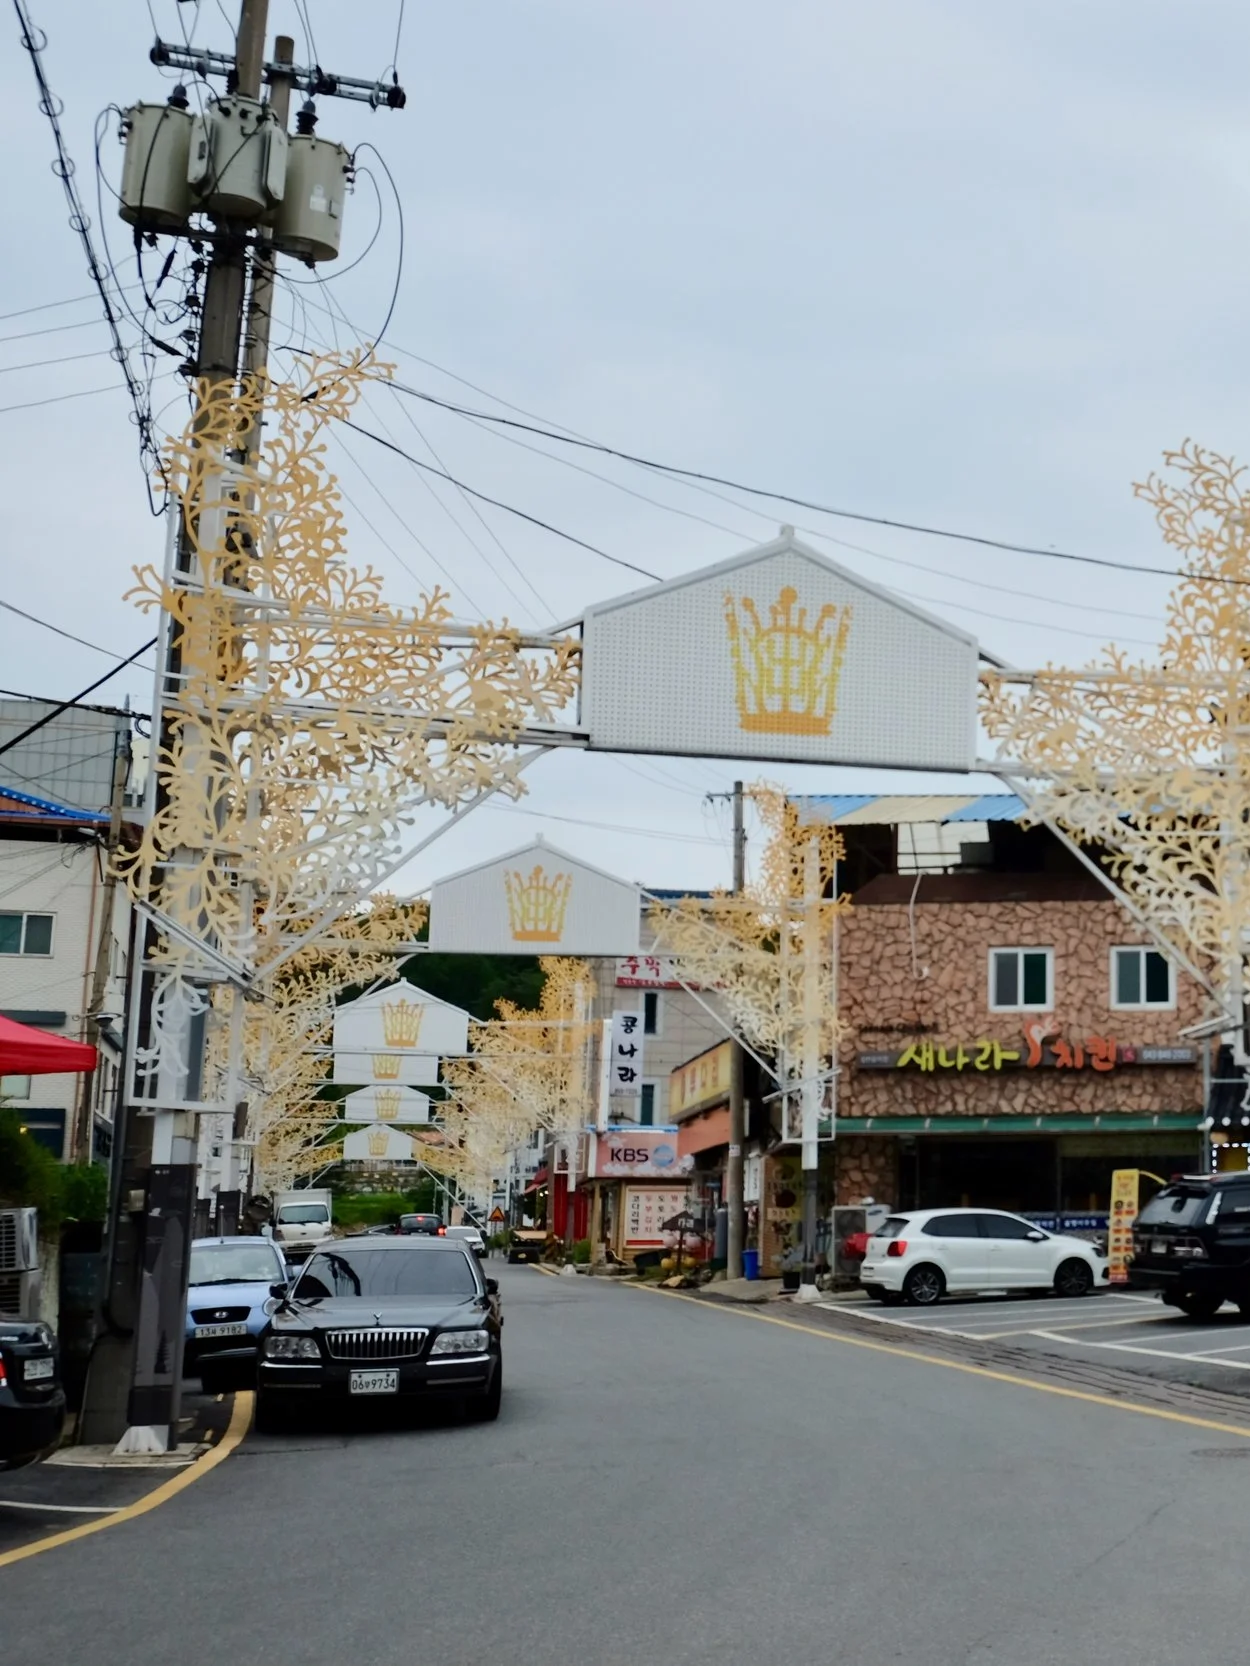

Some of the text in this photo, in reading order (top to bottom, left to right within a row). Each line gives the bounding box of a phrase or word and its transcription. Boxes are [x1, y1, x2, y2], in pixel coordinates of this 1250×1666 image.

[897, 1036, 1117, 1072] 새나라 치킨
[610, 1148, 649, 1163] KBS
